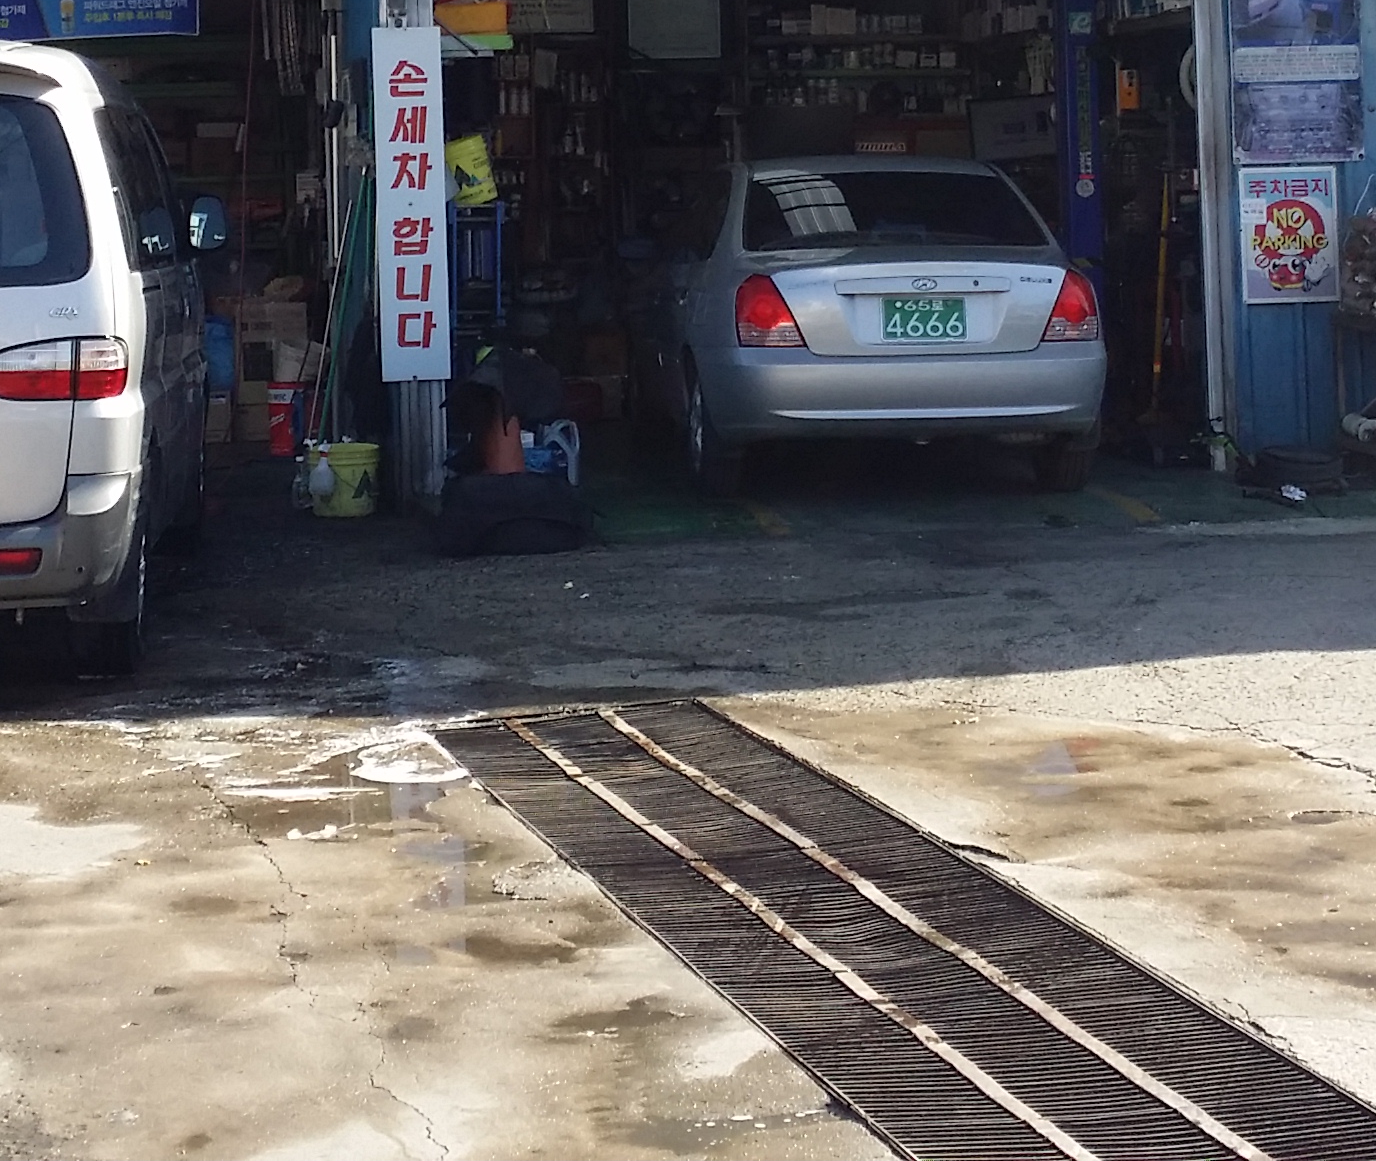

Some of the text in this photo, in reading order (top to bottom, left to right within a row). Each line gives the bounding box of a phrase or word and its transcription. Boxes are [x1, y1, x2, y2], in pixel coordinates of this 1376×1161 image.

[1248, 178, 1329, 199] 주차금지
[388, 60, 437, 350] 손세차 합니다
[1272, 206, 1306, 229] NO
[1250, 233, 1329, 251] PARKING
[903, 299, 945, 312] 65로
[886, 311, 964, 337] 4666
